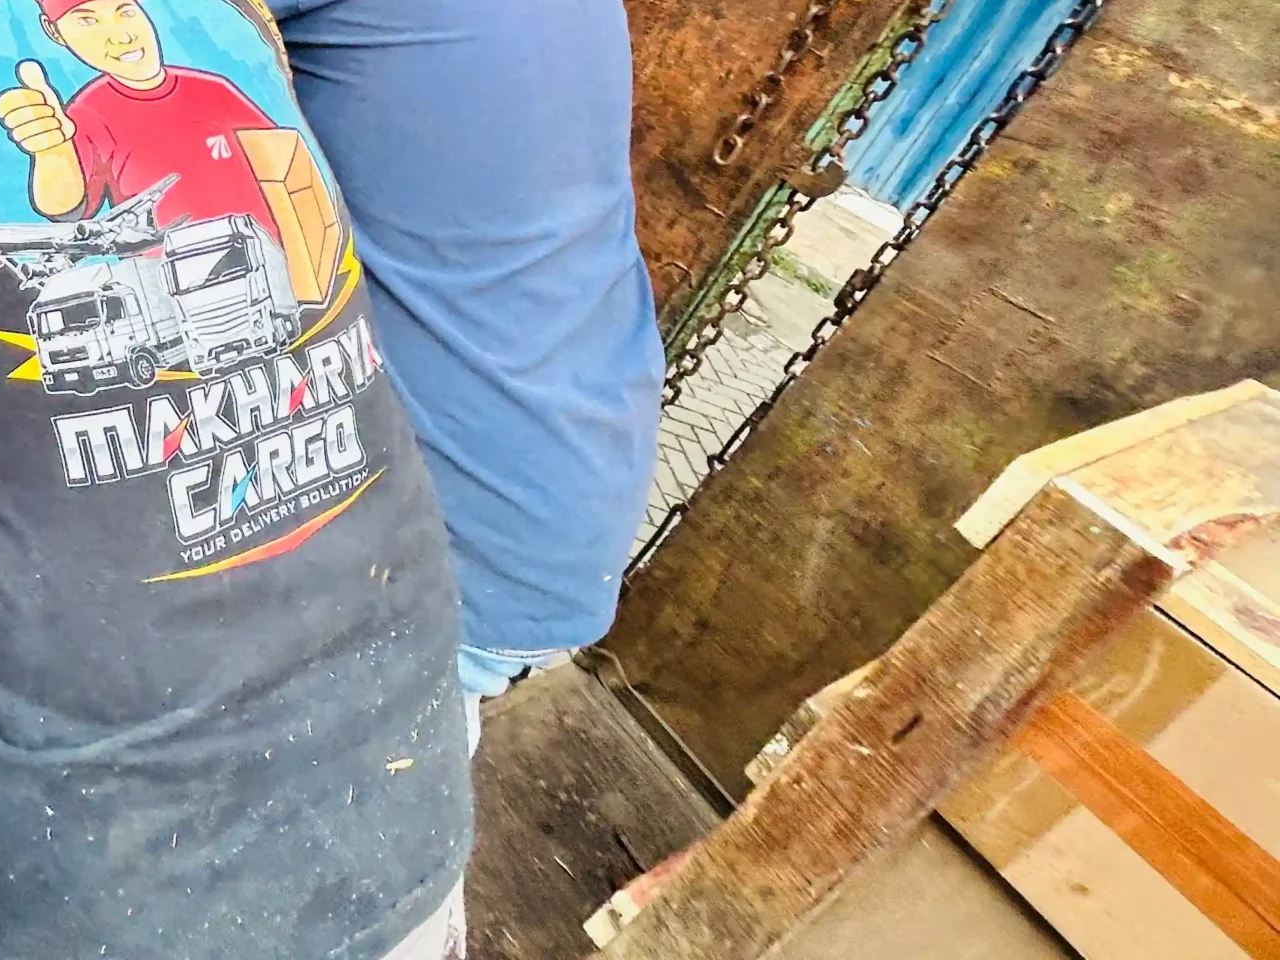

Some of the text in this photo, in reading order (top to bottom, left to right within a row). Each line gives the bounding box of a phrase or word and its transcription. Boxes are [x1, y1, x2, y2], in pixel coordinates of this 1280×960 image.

[50, 315, 384, 488] MAKHARYA
[166, 402, 367, 546] CARGO
[179, 468, 370, 565] YOUR DELIVERY SOLUTION
